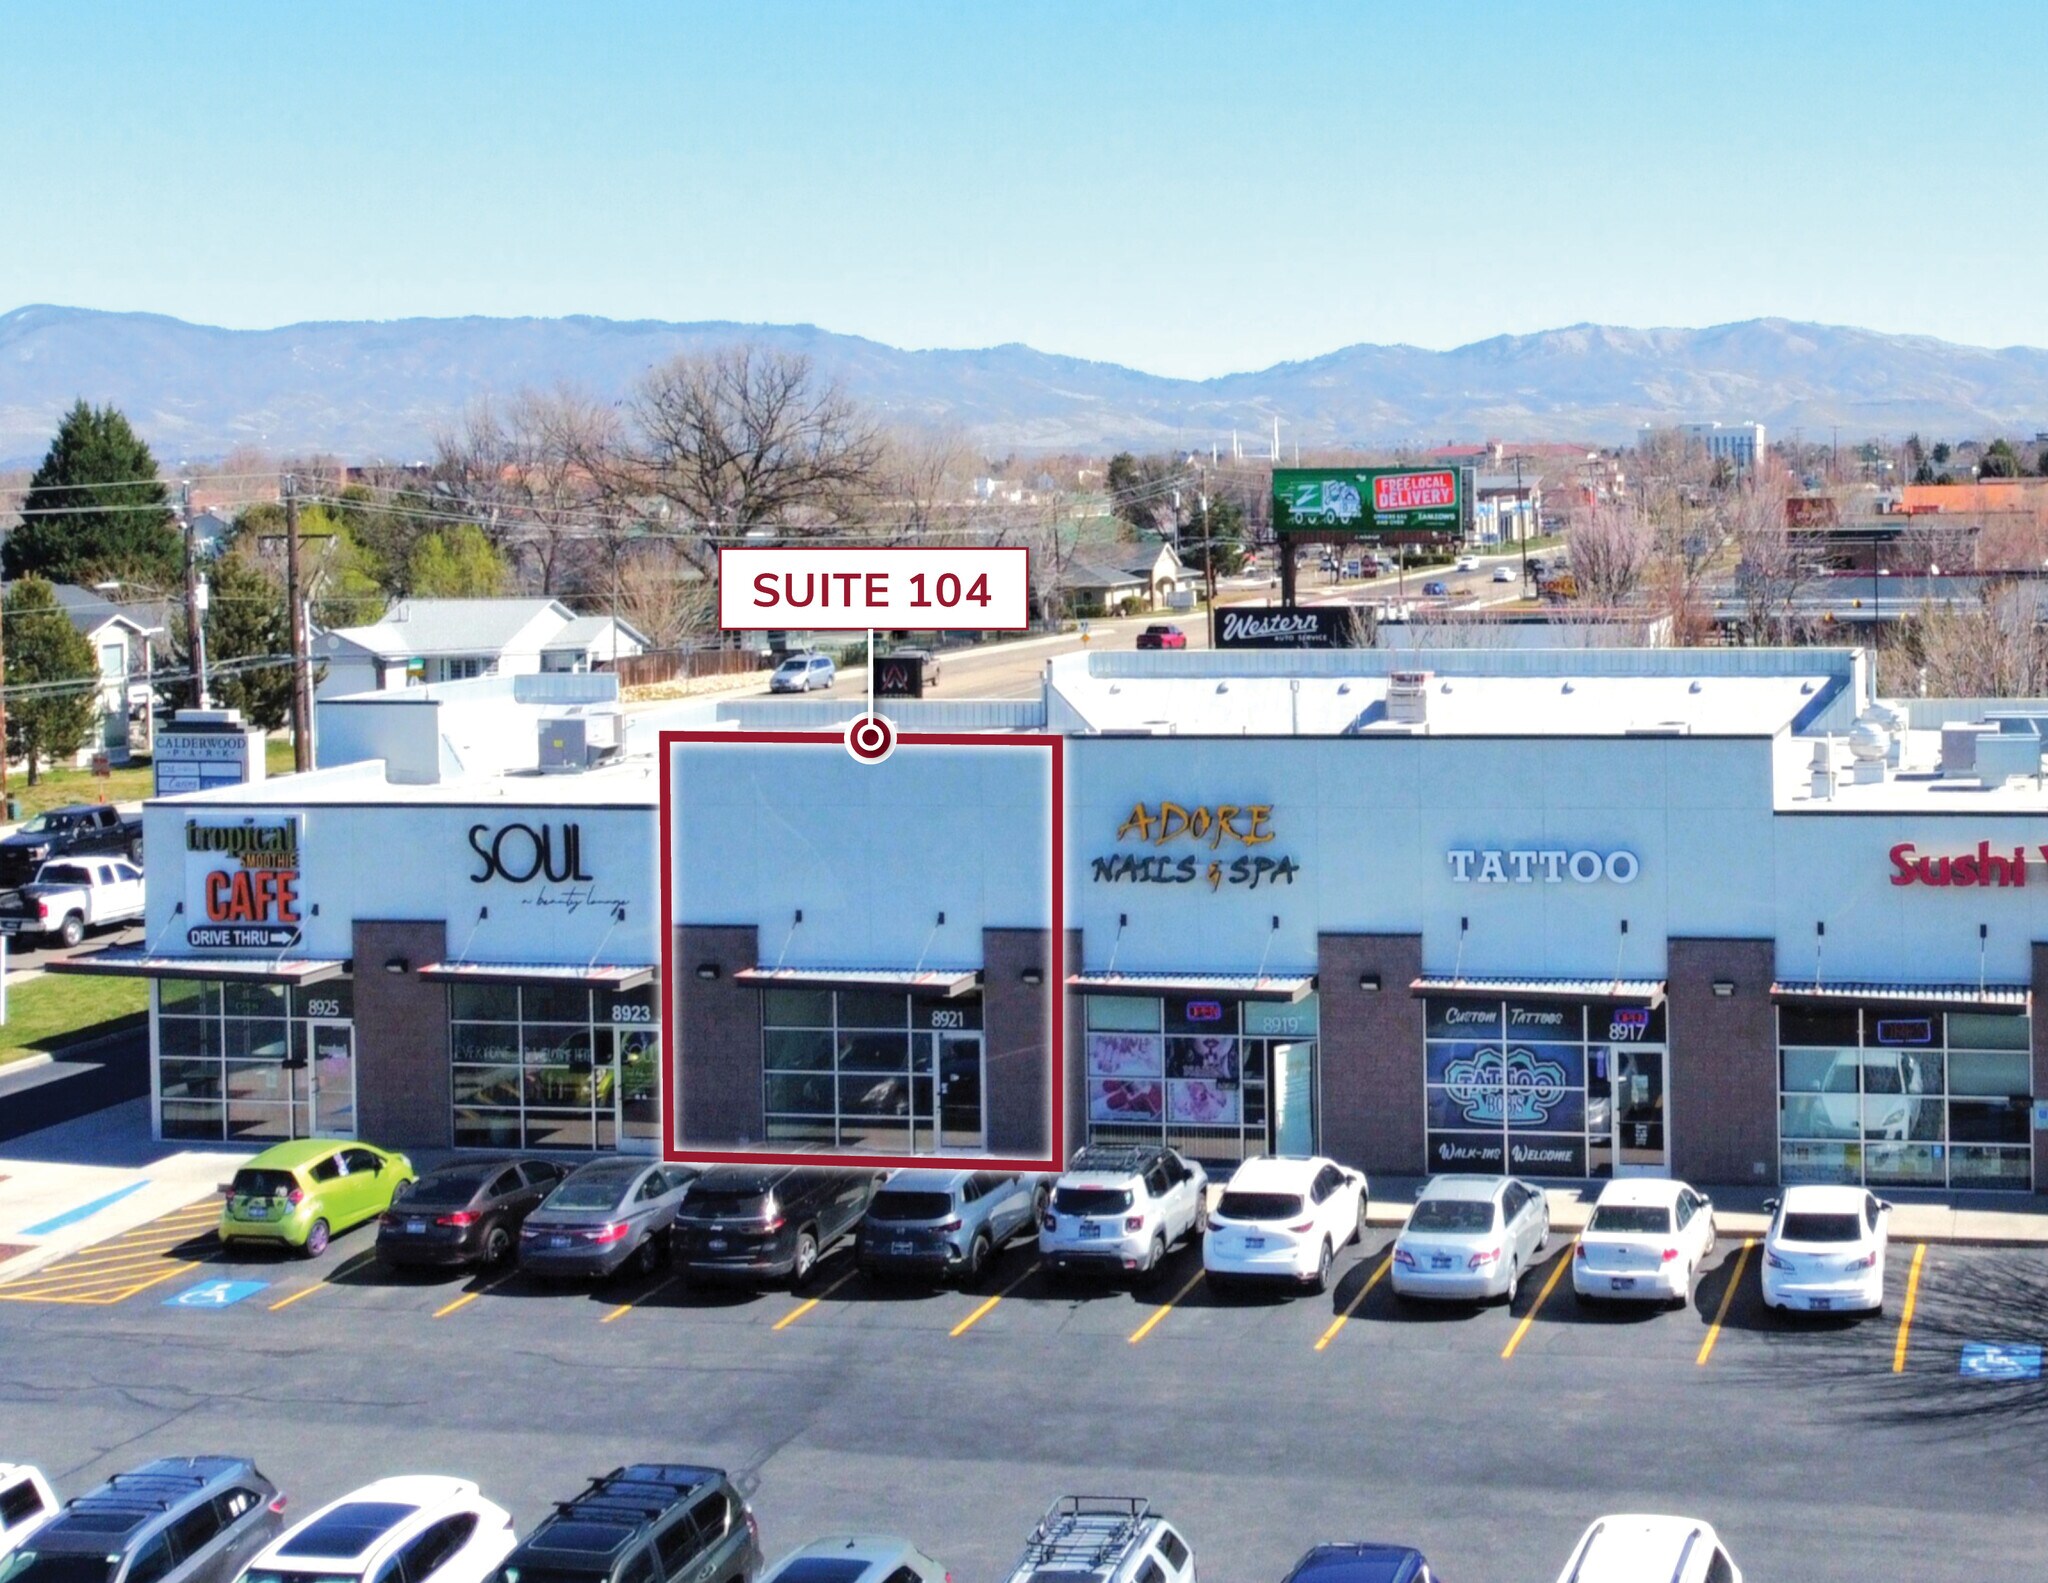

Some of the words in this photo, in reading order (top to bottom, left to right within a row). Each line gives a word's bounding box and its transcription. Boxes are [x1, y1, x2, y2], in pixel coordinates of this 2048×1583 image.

[1381, 477, 1410, 493] FREE
[1412, 475, 1446, 489] LOCAL
[1379, 488, 1449, 507] DELIVERY
[1223, 613, 1318, 641] Western
[1274, 634, 1295, 642] AUTO
[1298, 634, 1327, 642] SERVICE
[156, 737, 246, 749] CALDERWOOD
[1117, 801, 1275, 849] ADORE
[185, 817, 297, 858] tropical
[241, 852, 299, 868] SMOOTHIE
[469, 823, 593, 883] SOUL
[1091, 853, 1197, 883] NAILS
[1228, 854, 1300, 889] SPA
[1447, 850, 1639, 884] TATTOO
[1889, 840, 2025, 887] Sushi
[205, 870, 301, 922] CAFE
[536, 886, 583, 914] beauty
[586, 885, 630, 916] lounge
[190, 930, 230, 946] DRIVE
[233, 930, 269, 946] THRU
[308, 999, 339, 1016] 8925
[612, 1005, 651, 1021] 8923
[1511, 1008, 1563, 1025] TATTOOS
[931, 1010, 963, 1028] 8921
[1263, 1016, 1299, 1033] 8919
[1609, 1023, 1646, 1041] 8917
[1457, 1066, 1553, 1102] TATTOO
[1511, 1144, 1573, 1162] WELCOME
